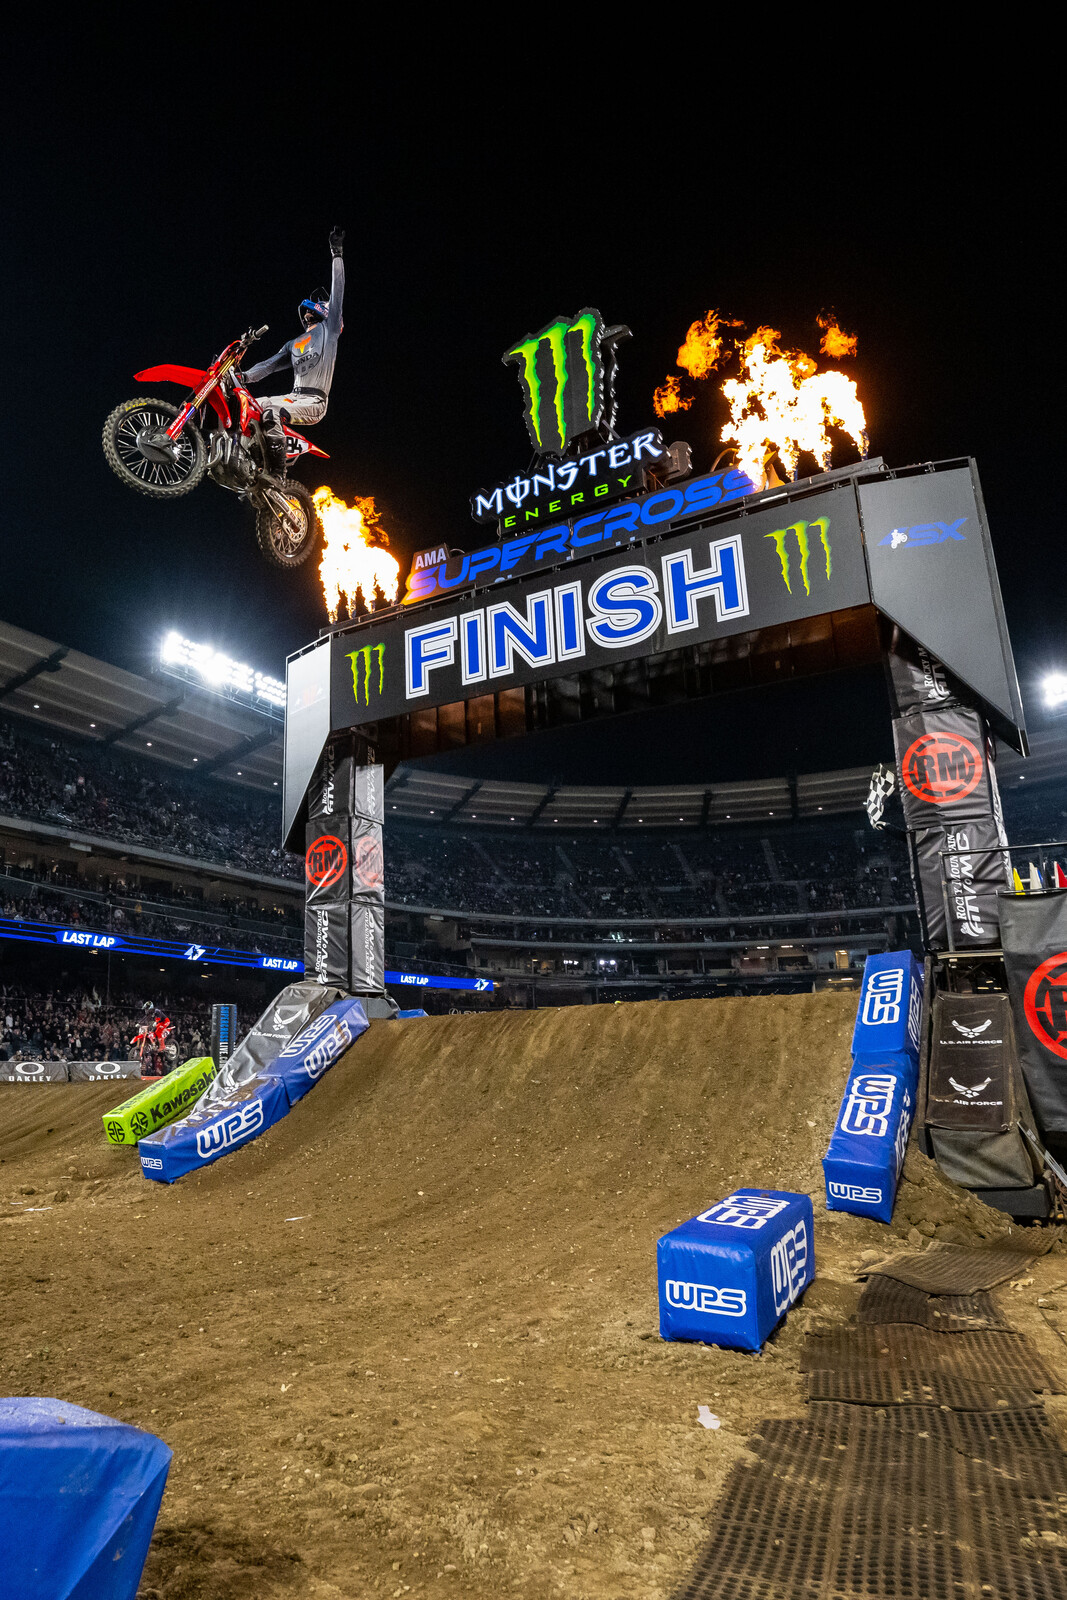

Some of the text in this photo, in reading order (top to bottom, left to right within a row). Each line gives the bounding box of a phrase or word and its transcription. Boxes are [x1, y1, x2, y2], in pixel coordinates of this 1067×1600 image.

[170, 407, 187, 430] DUNLOP
[475, 431, 663, 517] MONSTER
[504, 474, 634, 529] ENERGY
[400, 468, 760, 606] SUPERCROSS
[414, 547, 448, 571] AMA
[405, 533, 751, 700] FINISH
[914, 753, 967, 785] RM
[312, 847, 340, 869] RM
[62, 931, 116, 949] LAST LAP
[262, 957, 299, 971] LAST LAP
[314, 949, 322, 972] ROCKY
[400, 974, 429, 986] LAST LAP
[862, 968, 904, 1026] WPS
[279, 1014, 337, 1058] WPS
[303, 1019, 352, 1079] WPS
[8, 1075, 52, 1083] OAKLEY
[150, 1066, 217, 1125] Kawasaki
[840, 1074, 897, 1137] WPS
[196, 1099, 264, 1159] WPS
[140, 1156, 163, 1170] WPS
[828, 1181, 882, 1204] WPS
[696, 1194, 791, 1230] WPS
[665, 1279, 747, 1317] WPS
